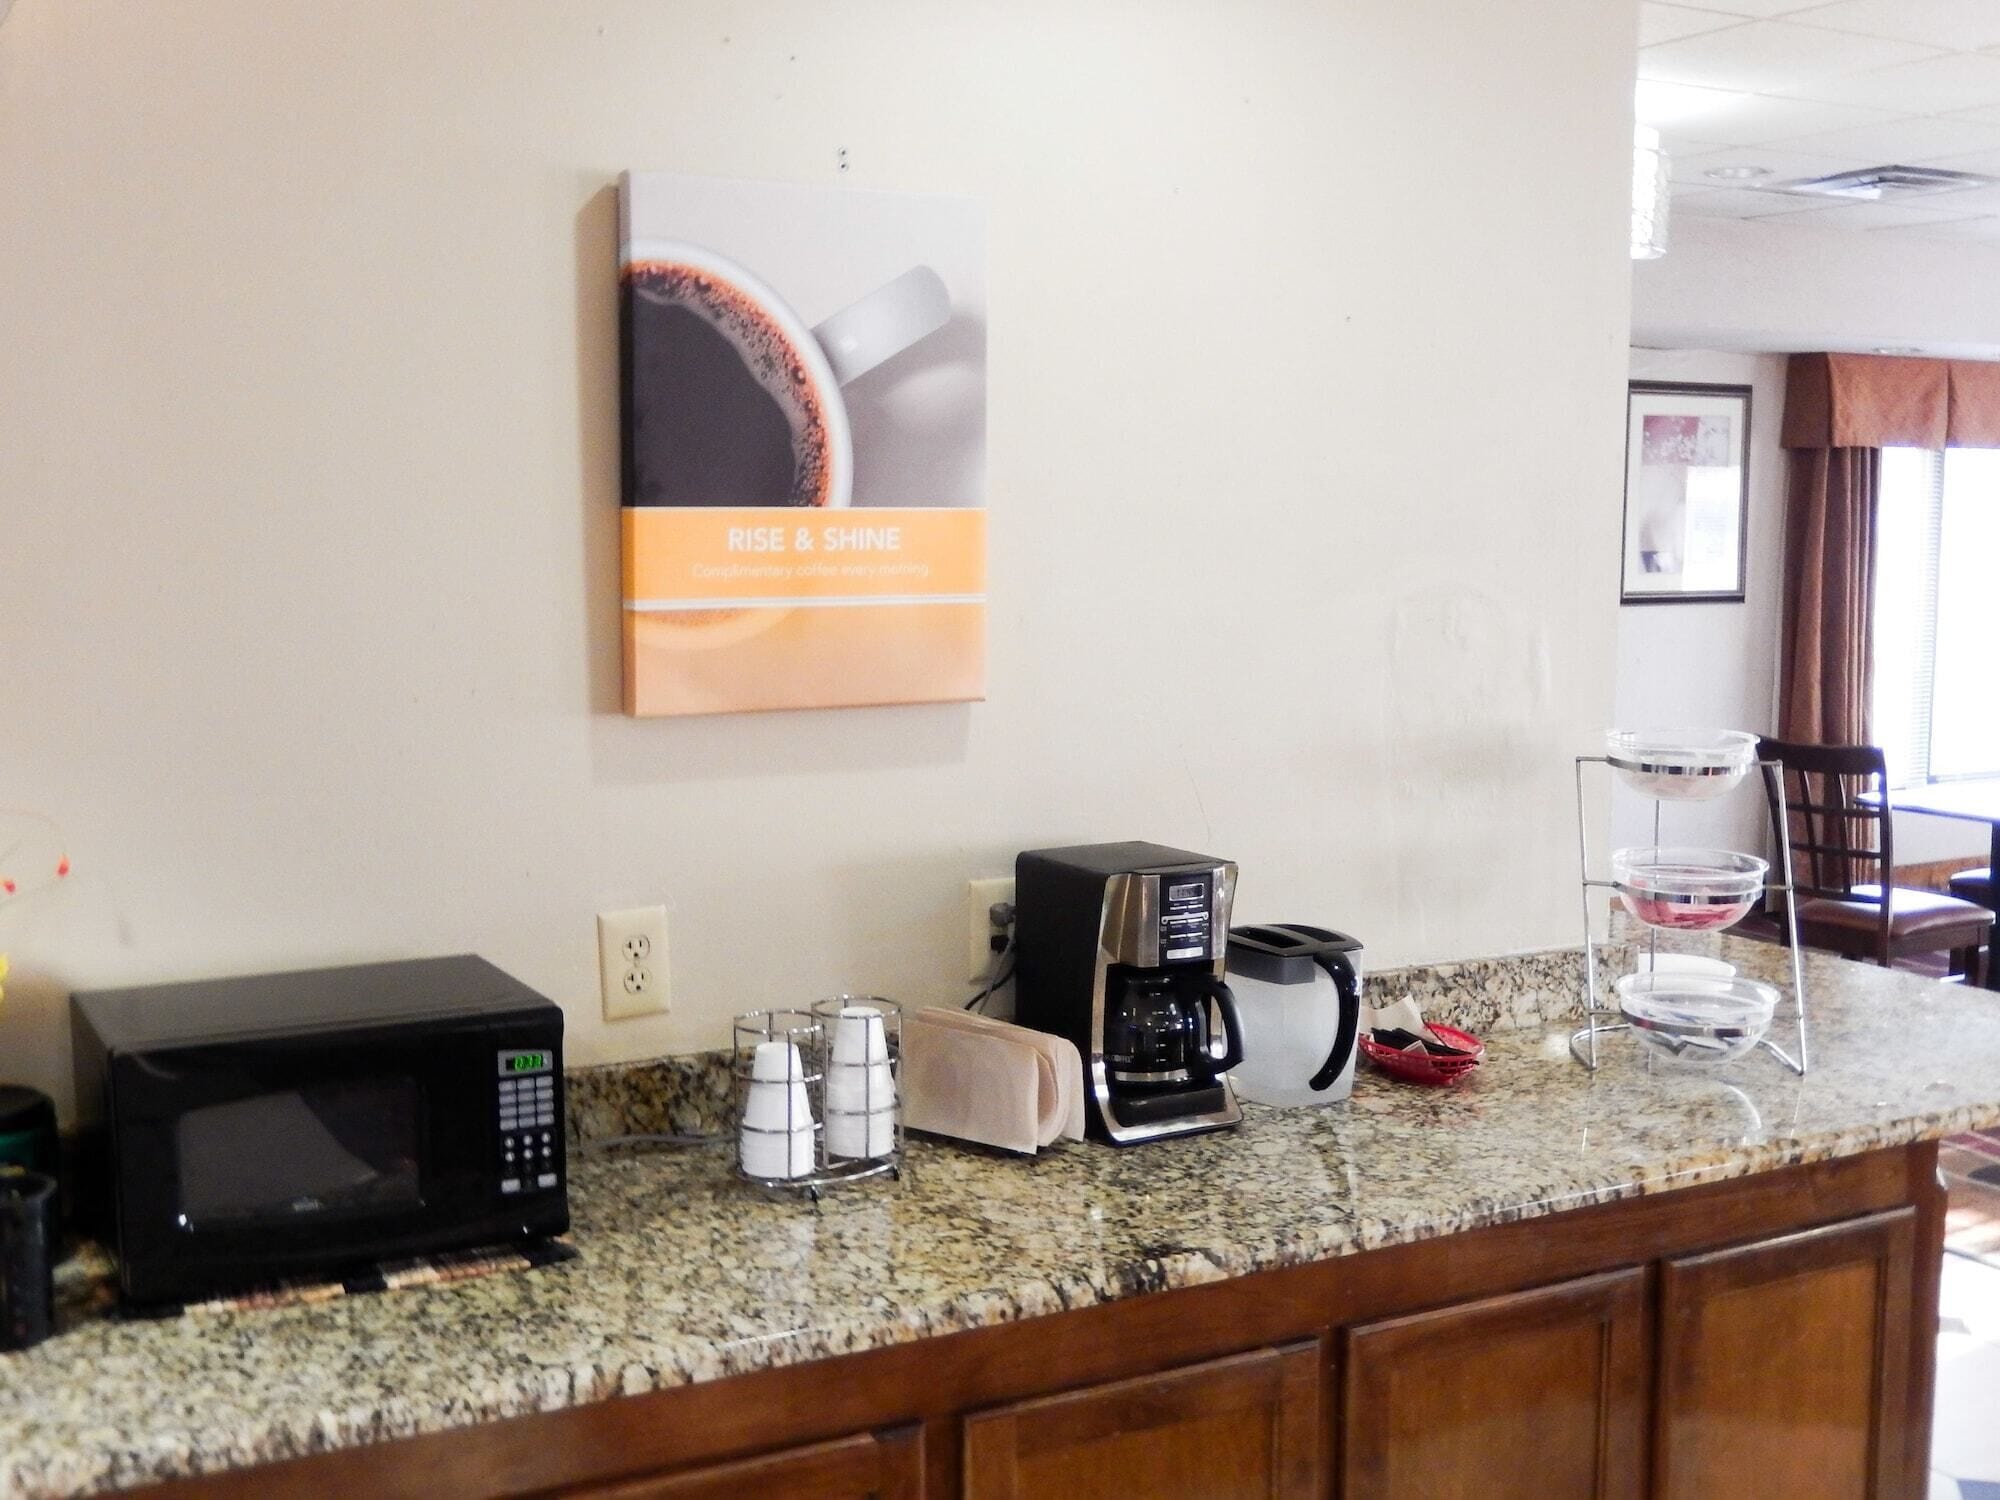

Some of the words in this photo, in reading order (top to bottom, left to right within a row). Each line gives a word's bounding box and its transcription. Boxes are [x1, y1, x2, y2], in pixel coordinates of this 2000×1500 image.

[728, 527, 785, 552] RISE
[795, 527, 815, 551] &
[823, 527, 901, 550] SHINE
[693, 563, 793, 581] Complimentary
[796, 561, 838, 576] coffee
[841, 561, 876, 578] every
[879, 560, 930, 577] morning
